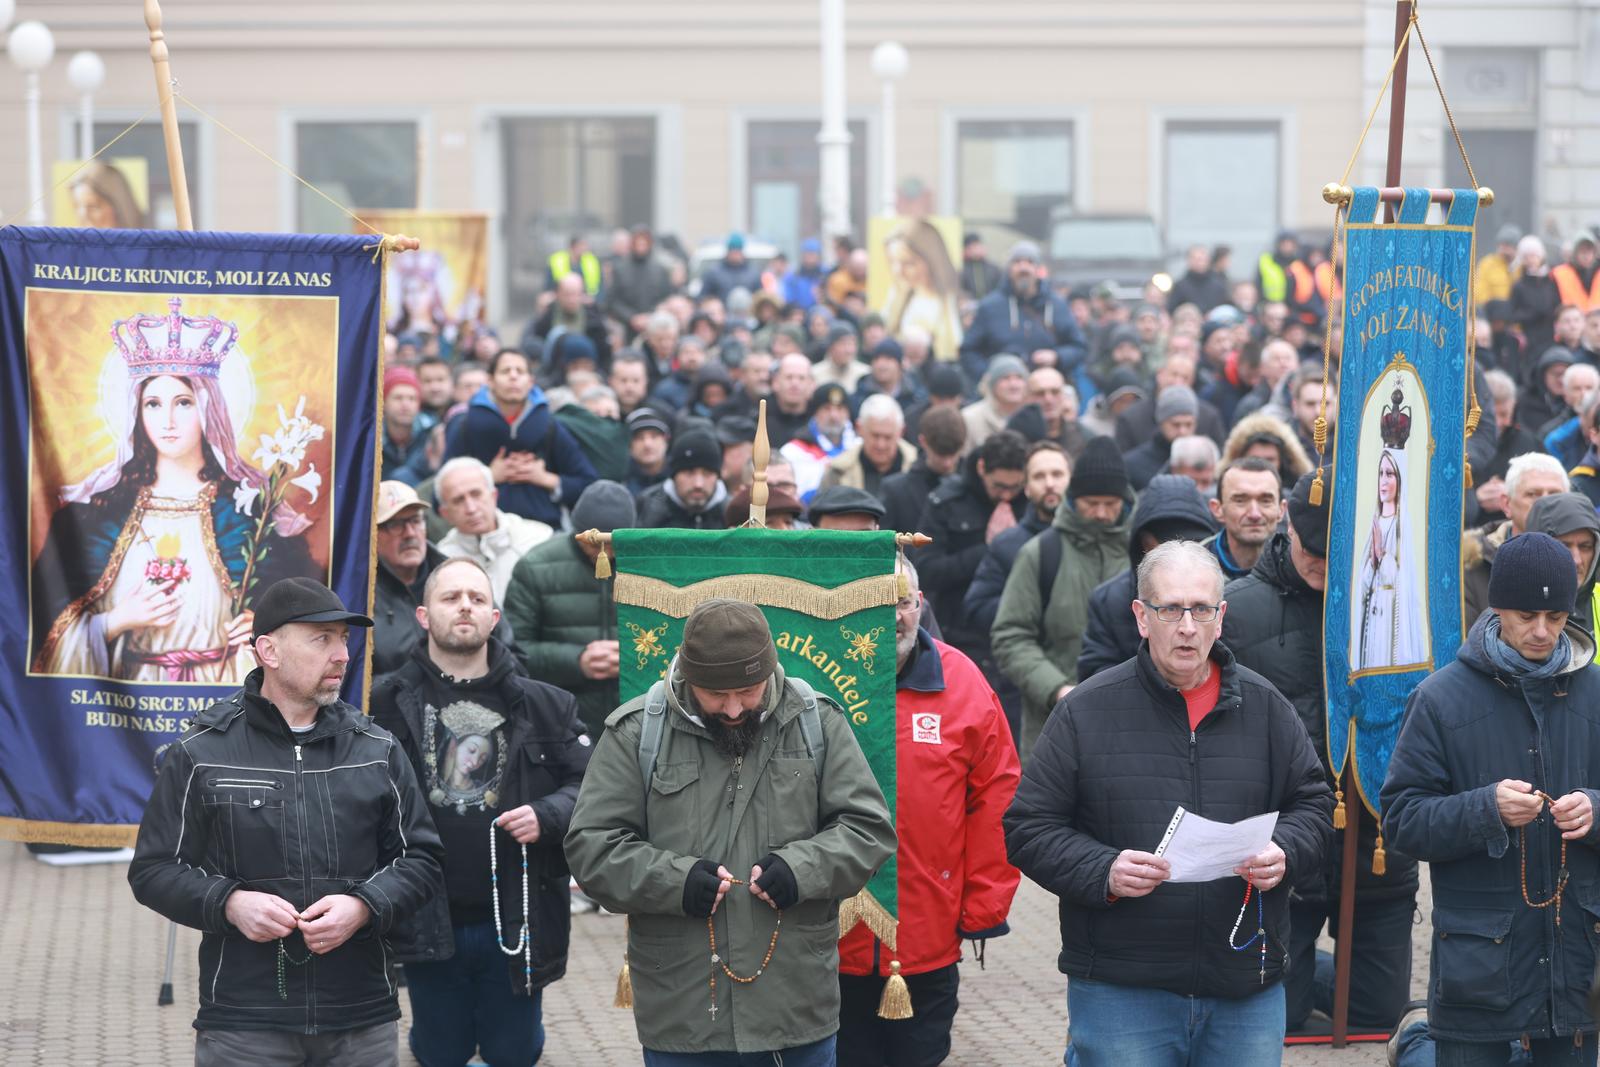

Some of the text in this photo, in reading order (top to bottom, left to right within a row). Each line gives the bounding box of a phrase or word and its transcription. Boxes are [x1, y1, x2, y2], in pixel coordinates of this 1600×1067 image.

[33, 263, 332, 288] KRALJICE KRUNICE, MOLI ZA NAS
[1351, 269, 1393, 316] GOPA
[1395, 304, 1419, 331] ZA
[1419, 310, 1448, 349] NAS
[776, 631, 869, 726] arkanđele
[70, 689, 224, 712] SLATKO SRCE MA
[86, 711, 128, 728] BUDI
[131, 714, 177, 733] NAŠE
